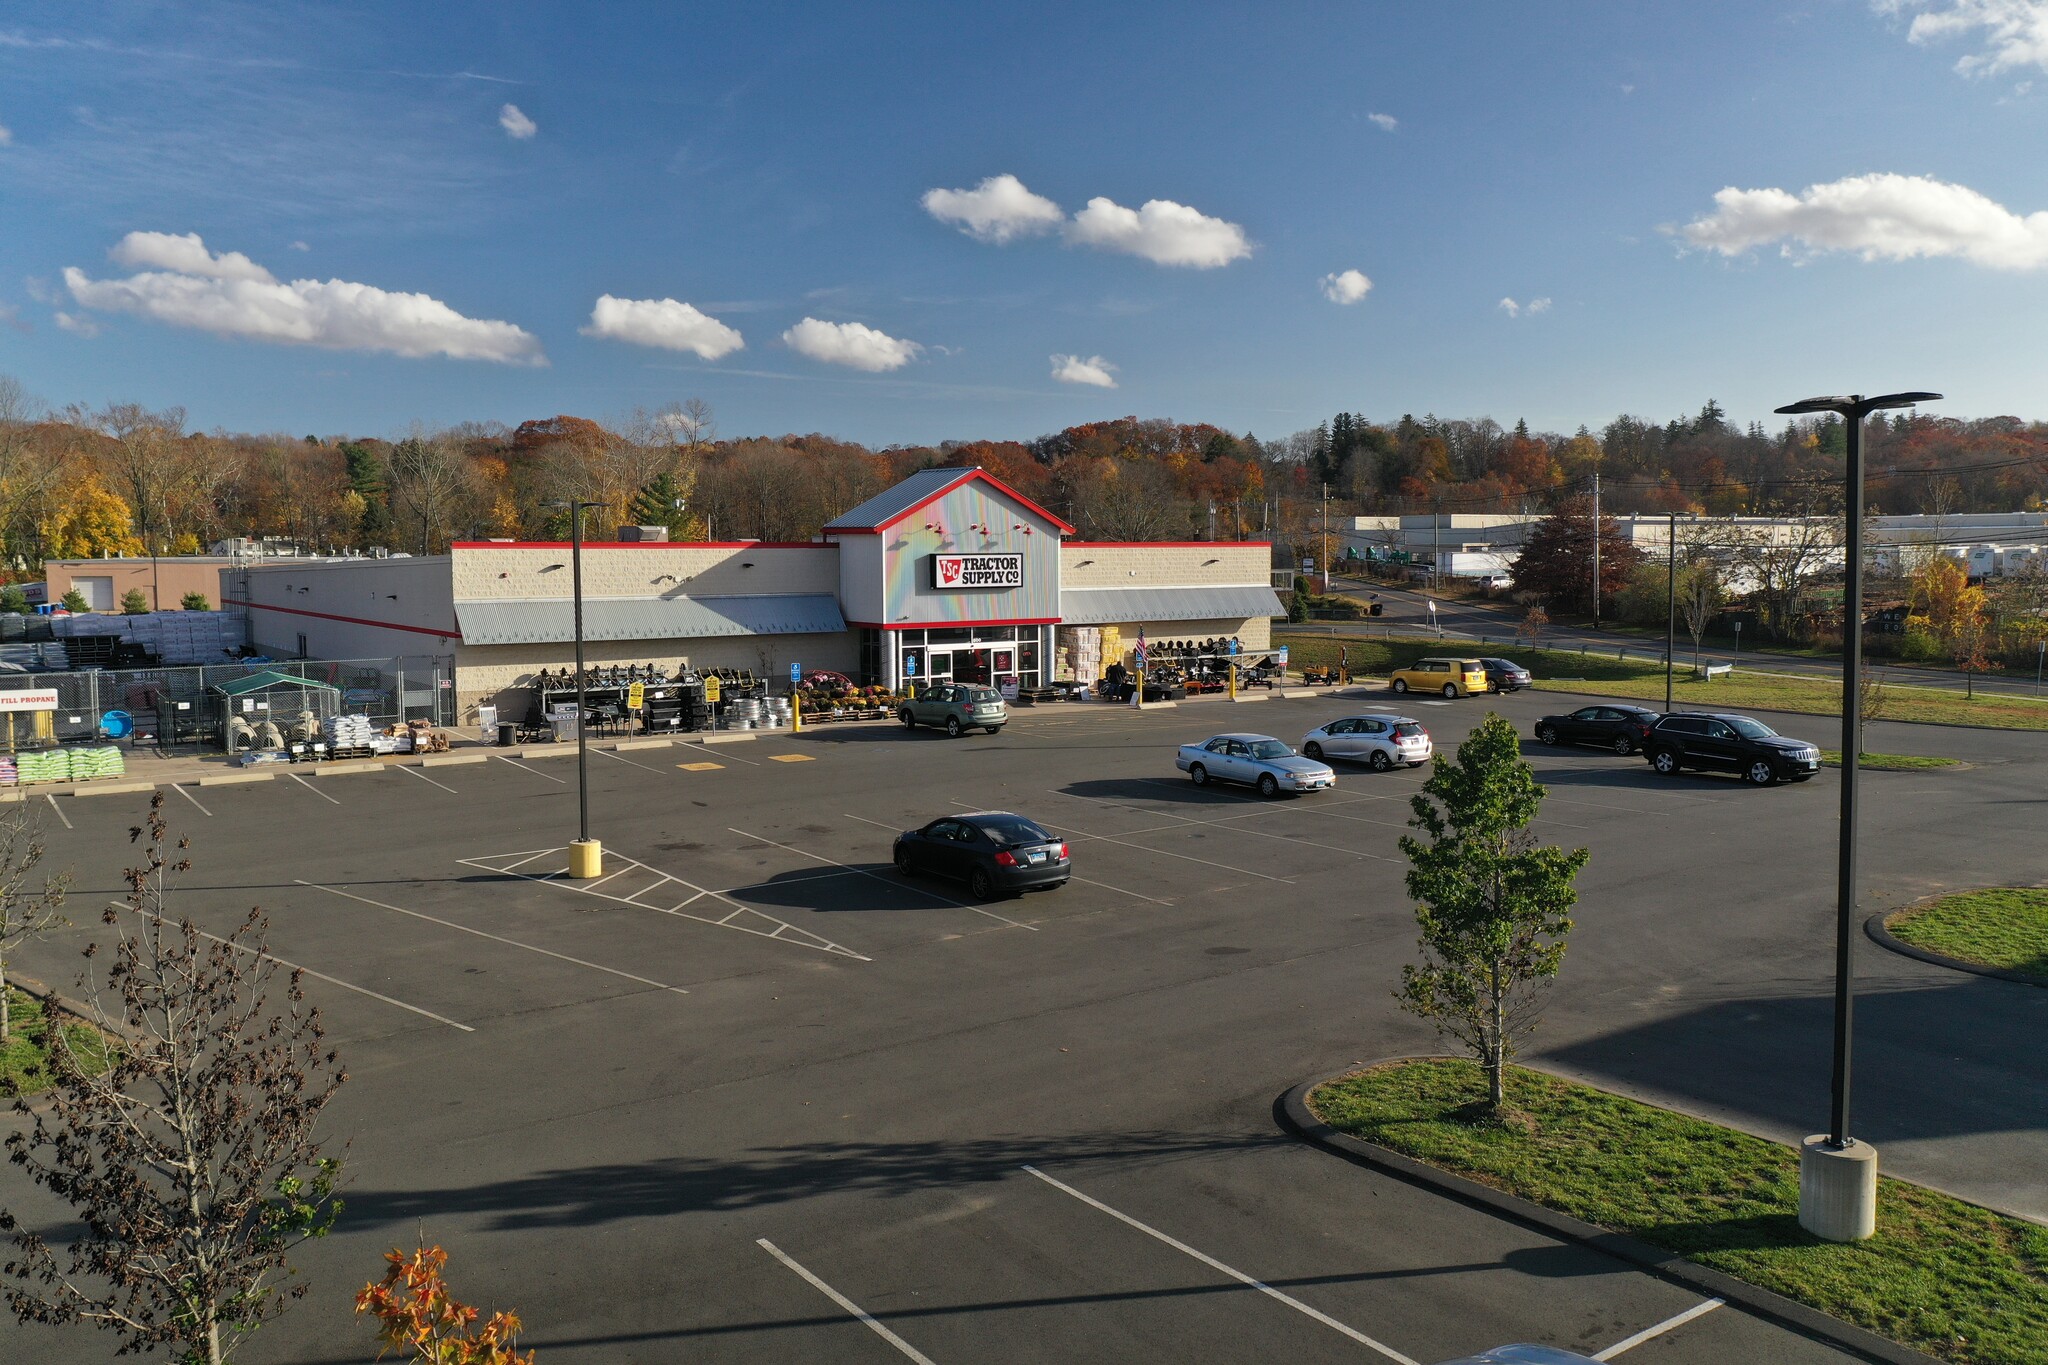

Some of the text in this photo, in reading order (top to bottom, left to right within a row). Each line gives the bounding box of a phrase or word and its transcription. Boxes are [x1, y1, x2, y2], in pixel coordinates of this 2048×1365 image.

[941, 560, 959, 579] TSC
[962, 557, 1018, 571] TRACTOR
[962, 571, 1005, 584] SUPPLY
[20, 696, 56, 704] PROPANE
